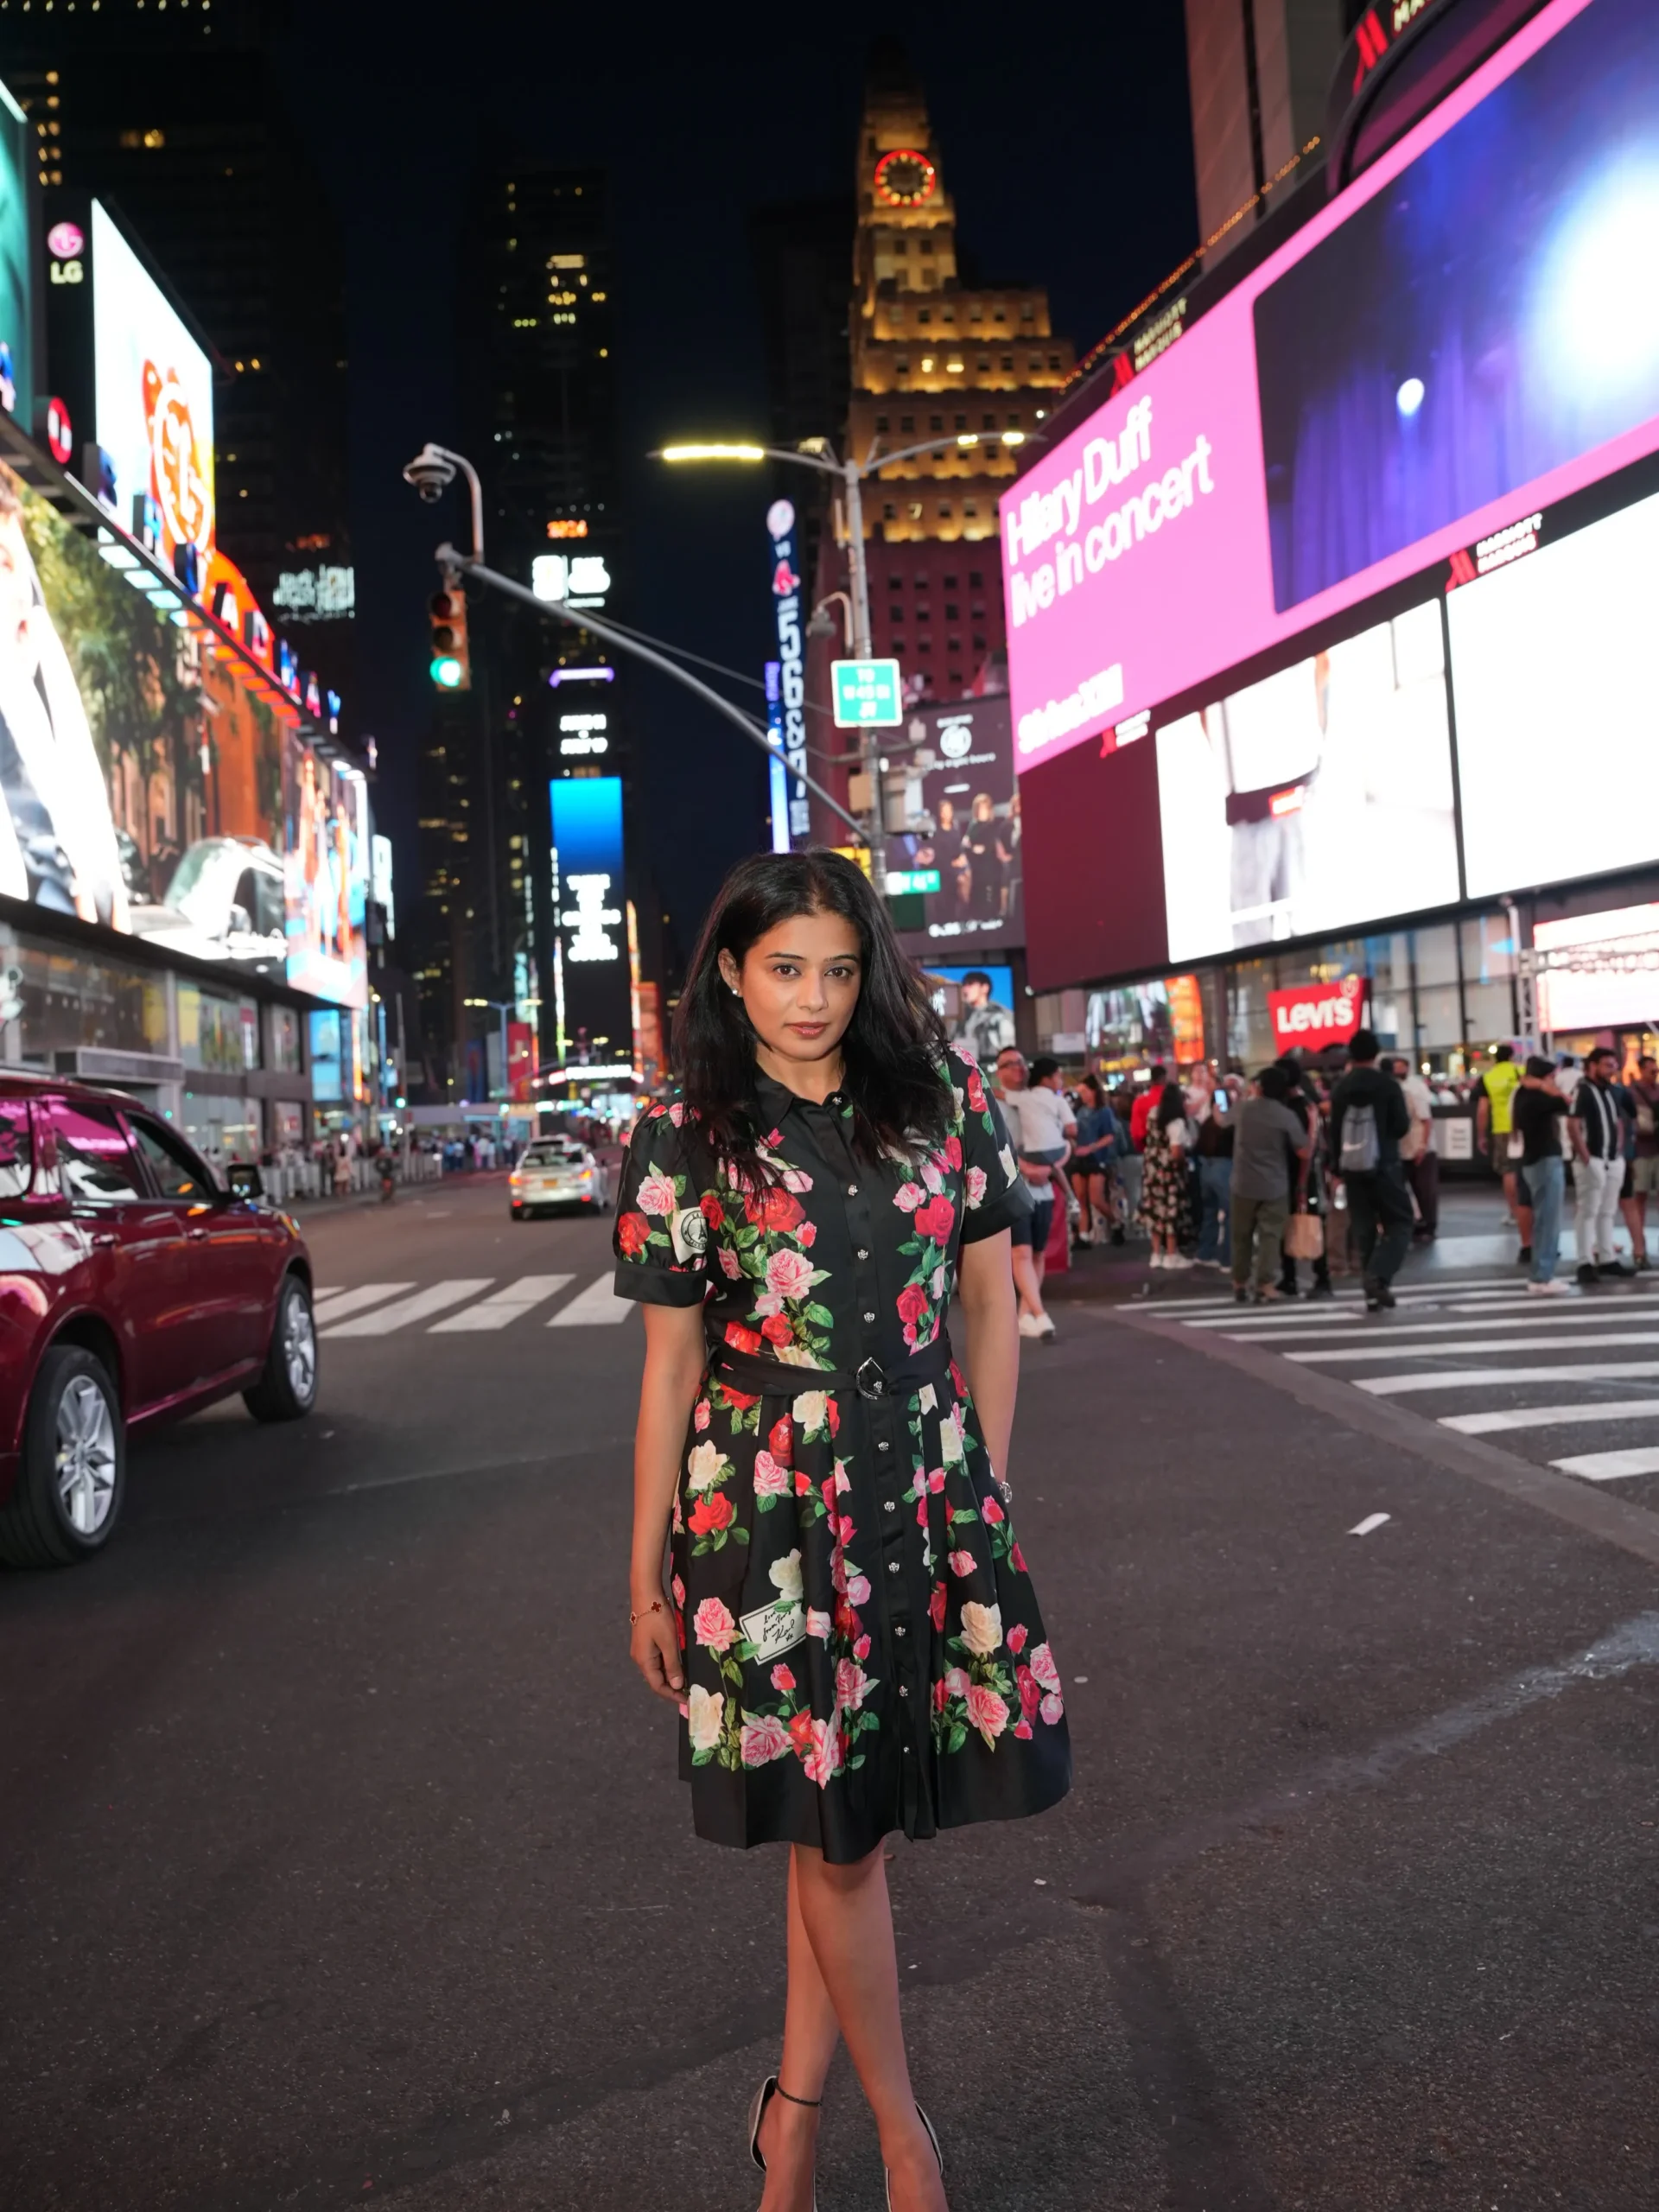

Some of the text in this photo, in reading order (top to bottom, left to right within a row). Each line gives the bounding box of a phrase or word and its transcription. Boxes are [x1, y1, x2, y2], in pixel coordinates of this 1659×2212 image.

[50, 260, 83, 284] LG
[1083, 395, 1153, 505] Duff
[1055, 541, 1084, 596] in
[1084, 434, 1214, 574] concert
